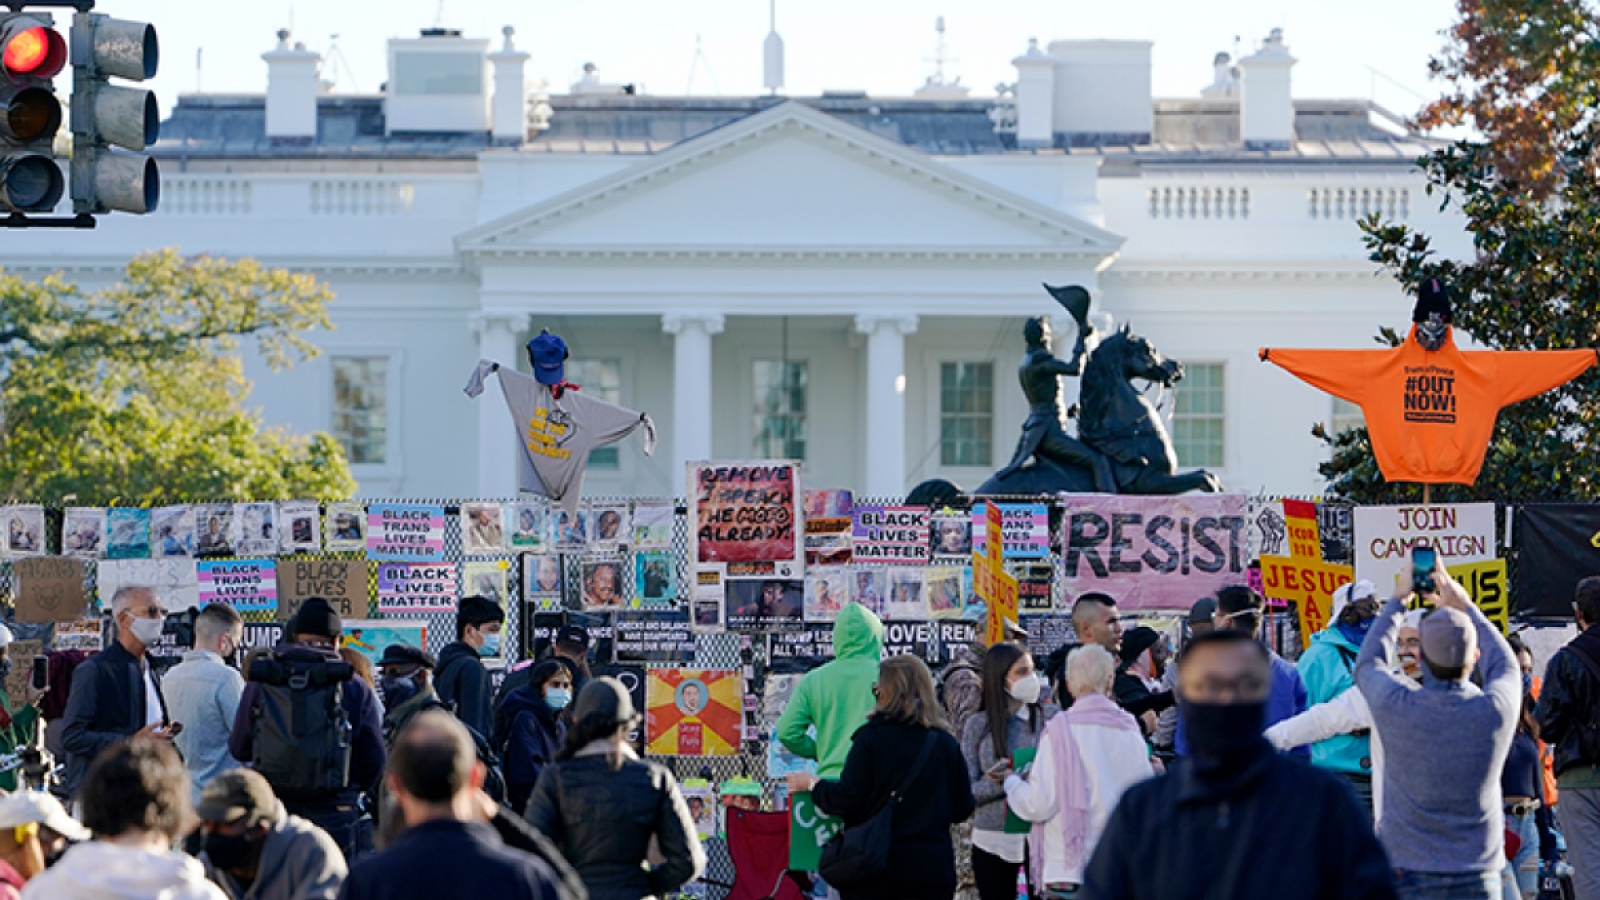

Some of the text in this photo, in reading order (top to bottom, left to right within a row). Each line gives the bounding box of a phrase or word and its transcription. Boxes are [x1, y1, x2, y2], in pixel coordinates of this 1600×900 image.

[1405, 376, 1455, 394] #OUT
[1404, 393, 1456, 412] NOW!
[700, 467, 790, 483] REMOVE
[382, 510, 430, 520] BLACK
[698, 507, 734, 523] THE
[861, 513, 923, 526] BLACK
[1398, 508, 1457, 531] JOIN
[383, 522, 430, 532] TRANS
[698, 524, 790, 542] ALREADY!
[385, 534, 426, 544] LIVES
[868, 530, 918, 541] LIVES
[1065, 511, 1245, 577] RESIST
[1370, 535, 1486, 559] CAMPAIGN
[376, 546, 435, 556] MATTER
[854, 546, 925, 557] MATTER
[211, 565, 260, 575] BLACK
[296, 562, 348, 580] BLACK
[386, 568, 449, 580] BLACK
[213, 576, 262, 585] TRANS
[216, 586, 258, 596] LIVES
[295, 581, 346, 595] LIVES
[395, 583, 444, 593] LIVES
[209, 597, 268, 605] MATTER
[380, 597, 452, 607] MATTER
[534, 627, 549, 639] NO
[773, 643, 793, 656] ALL
